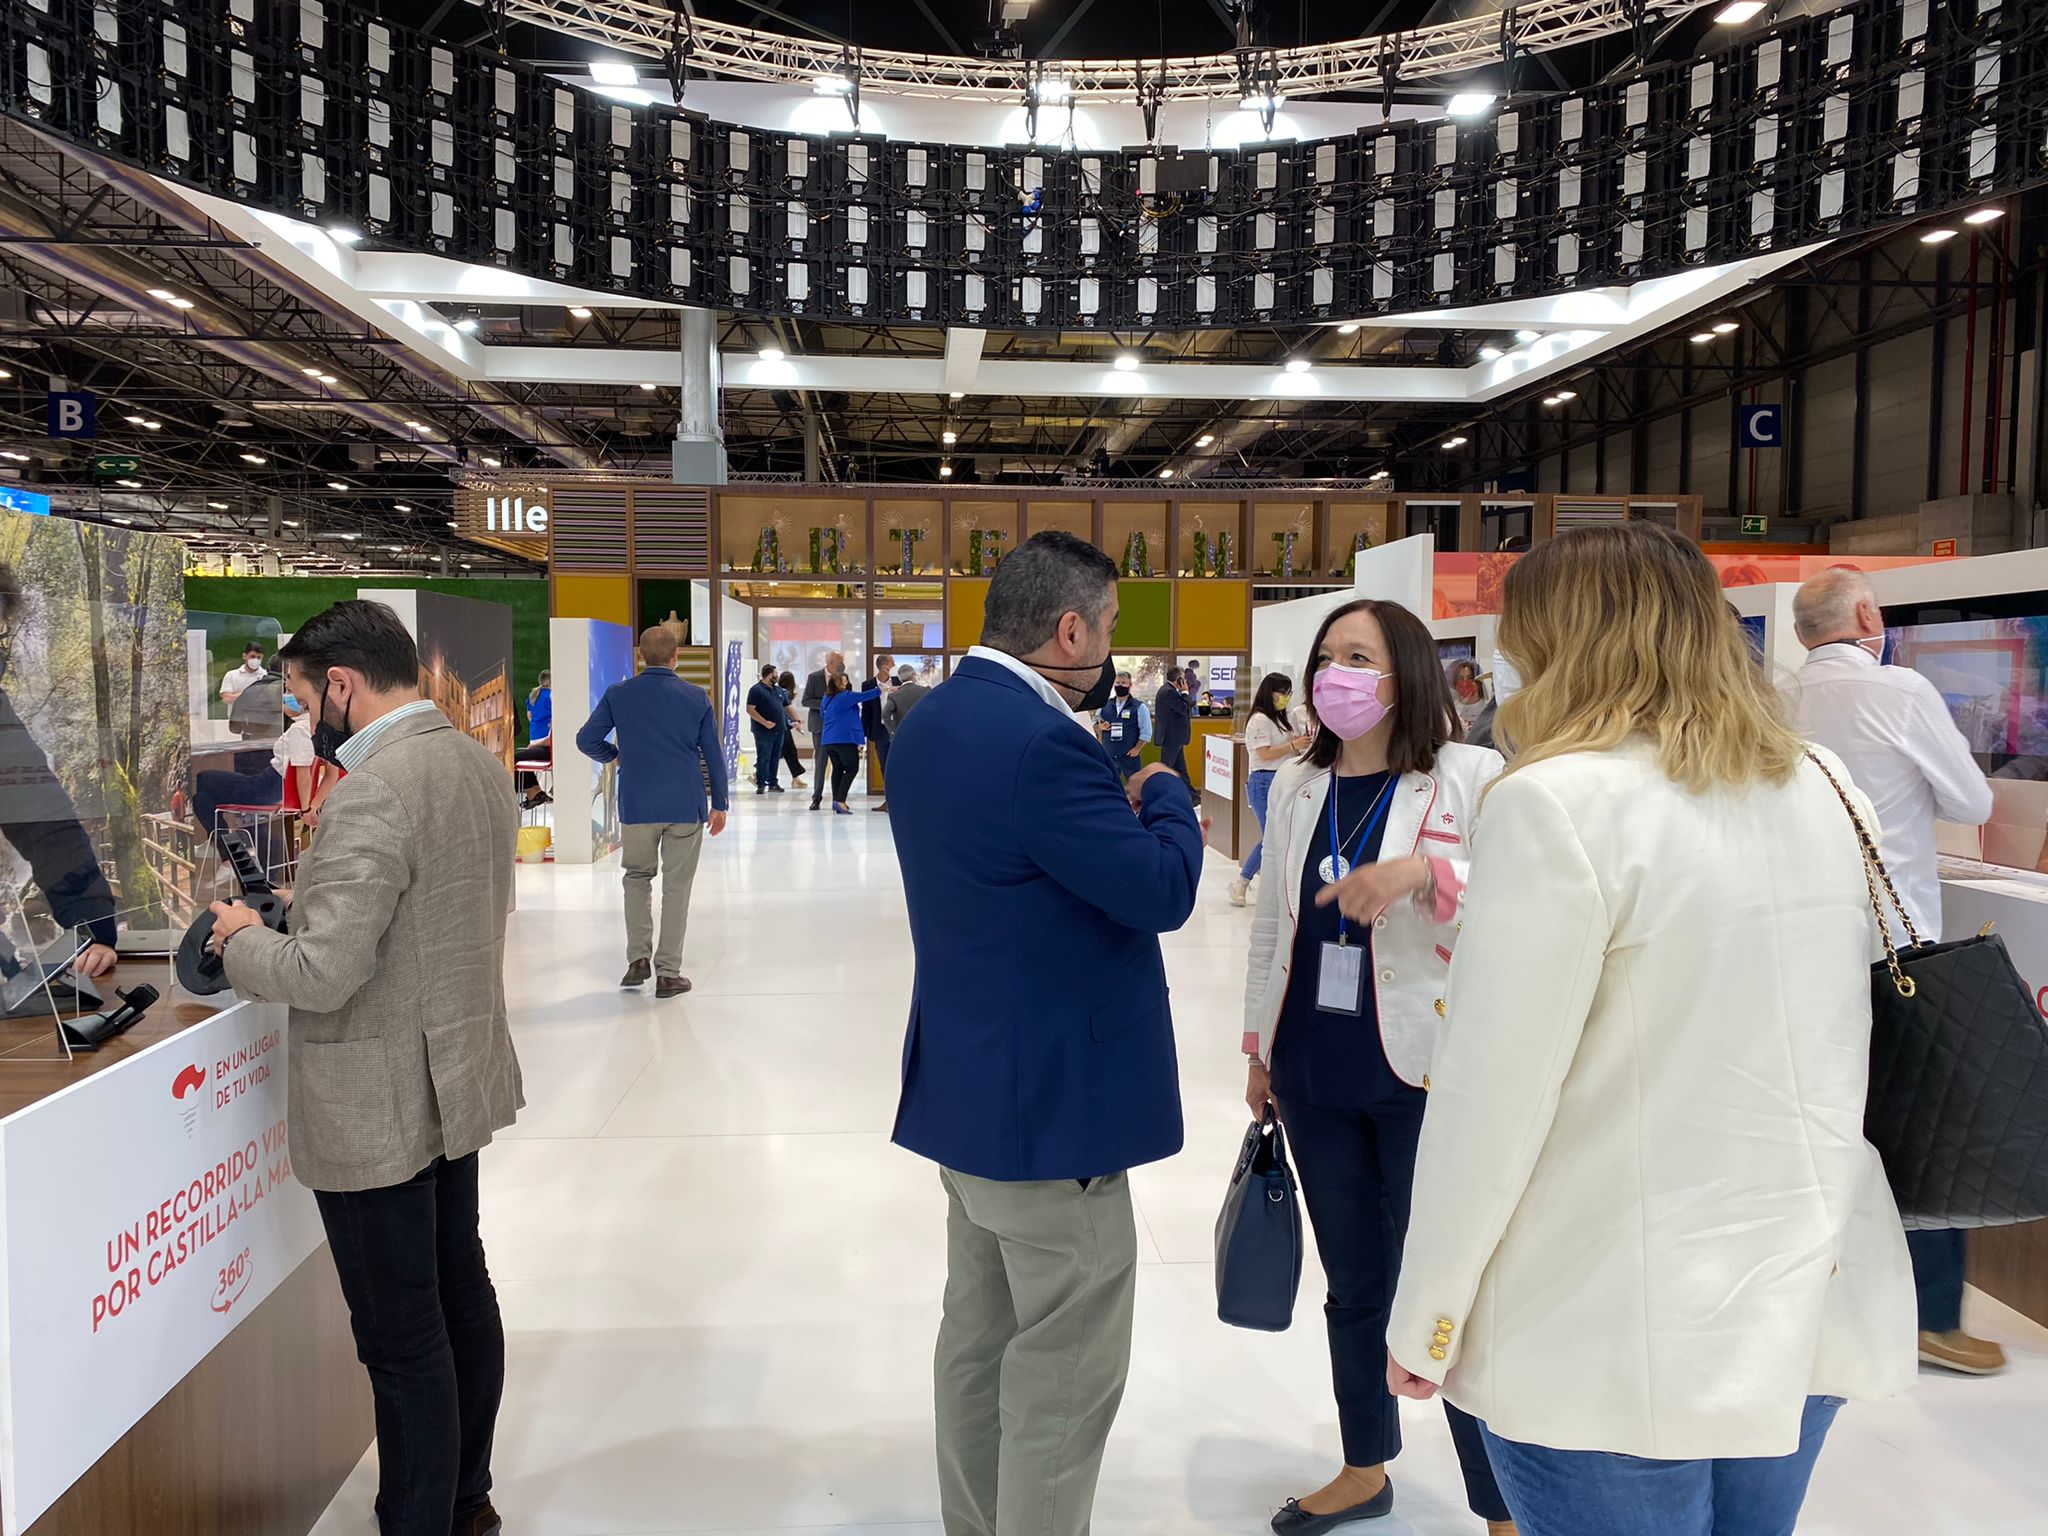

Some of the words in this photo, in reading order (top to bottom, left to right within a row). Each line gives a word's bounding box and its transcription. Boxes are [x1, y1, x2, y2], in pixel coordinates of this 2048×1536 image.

[59, 399, 83, 432] B
[1749, 410, 1773, 441] C
[487, 496, 548, 532] Ille
[216, 1056, 230, 1080] EN
[232, 1047, 247, 1070] UN
[249, 1029, 280, 1060] LUGAR
[216, 1086, 230, 1109] DE
[232, 1076, 246, 1098] TU
[248, 1064, 271, 1087] VIDA
[107, 1221, 139, 1272] UN
[146, 1140, 257, 1246] RECORRIDO
[262, 1119, 286, 1153] VIR
[92, 1268, 140, 1333] POR
[147, 1175, 264, 1285] CASTILLA-LA
[268, 1155, 293, 1193] MA
